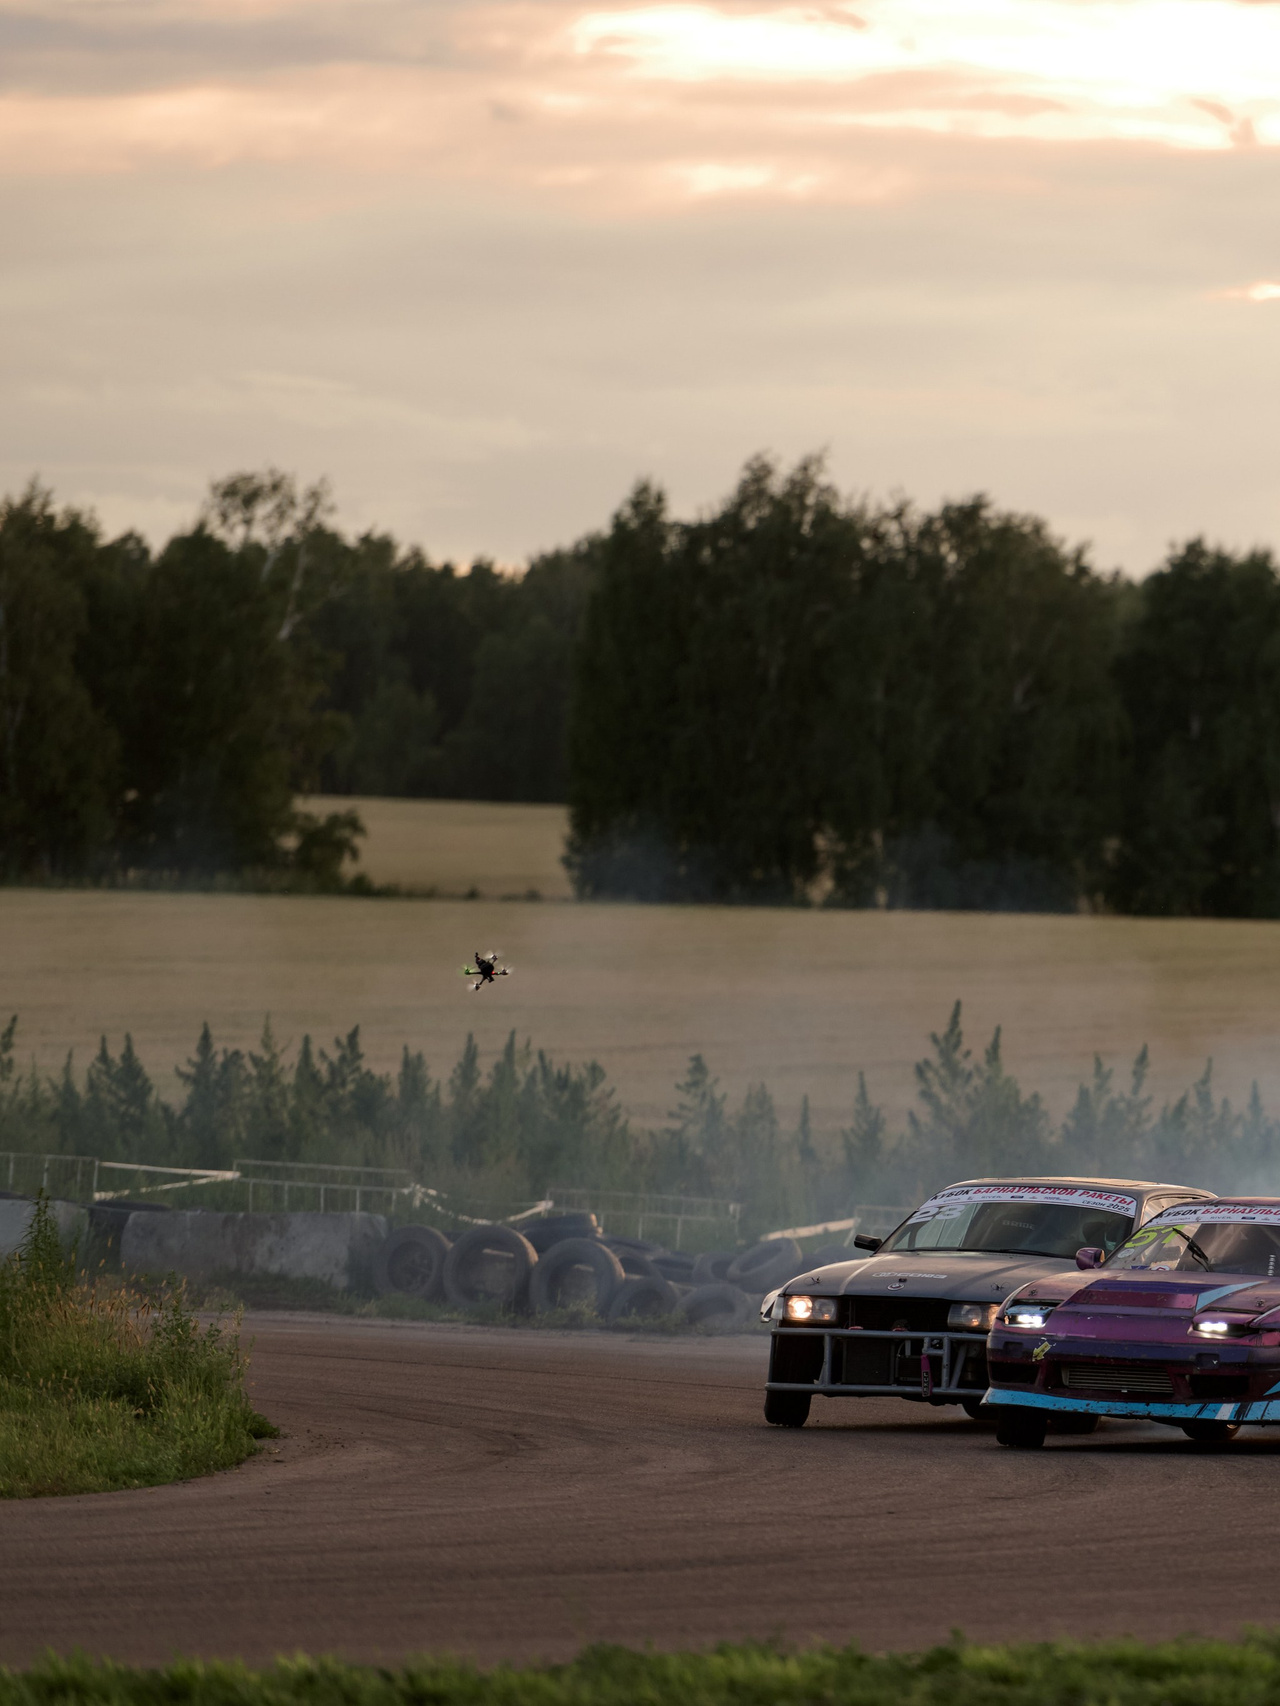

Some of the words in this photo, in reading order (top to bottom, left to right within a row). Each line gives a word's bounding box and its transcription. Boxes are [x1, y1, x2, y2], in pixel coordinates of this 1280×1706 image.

[931, 1188, 974, 1201] КУБОК
[973, 1187, 1078, 1196] БАРНАУЛЬСКОЙ
[1079, 1190, 1135, 1206] РАКЕТЫ
[906, 1204, 966, 1225] 23
[1106, 1202, 1131, 1212] 2025
